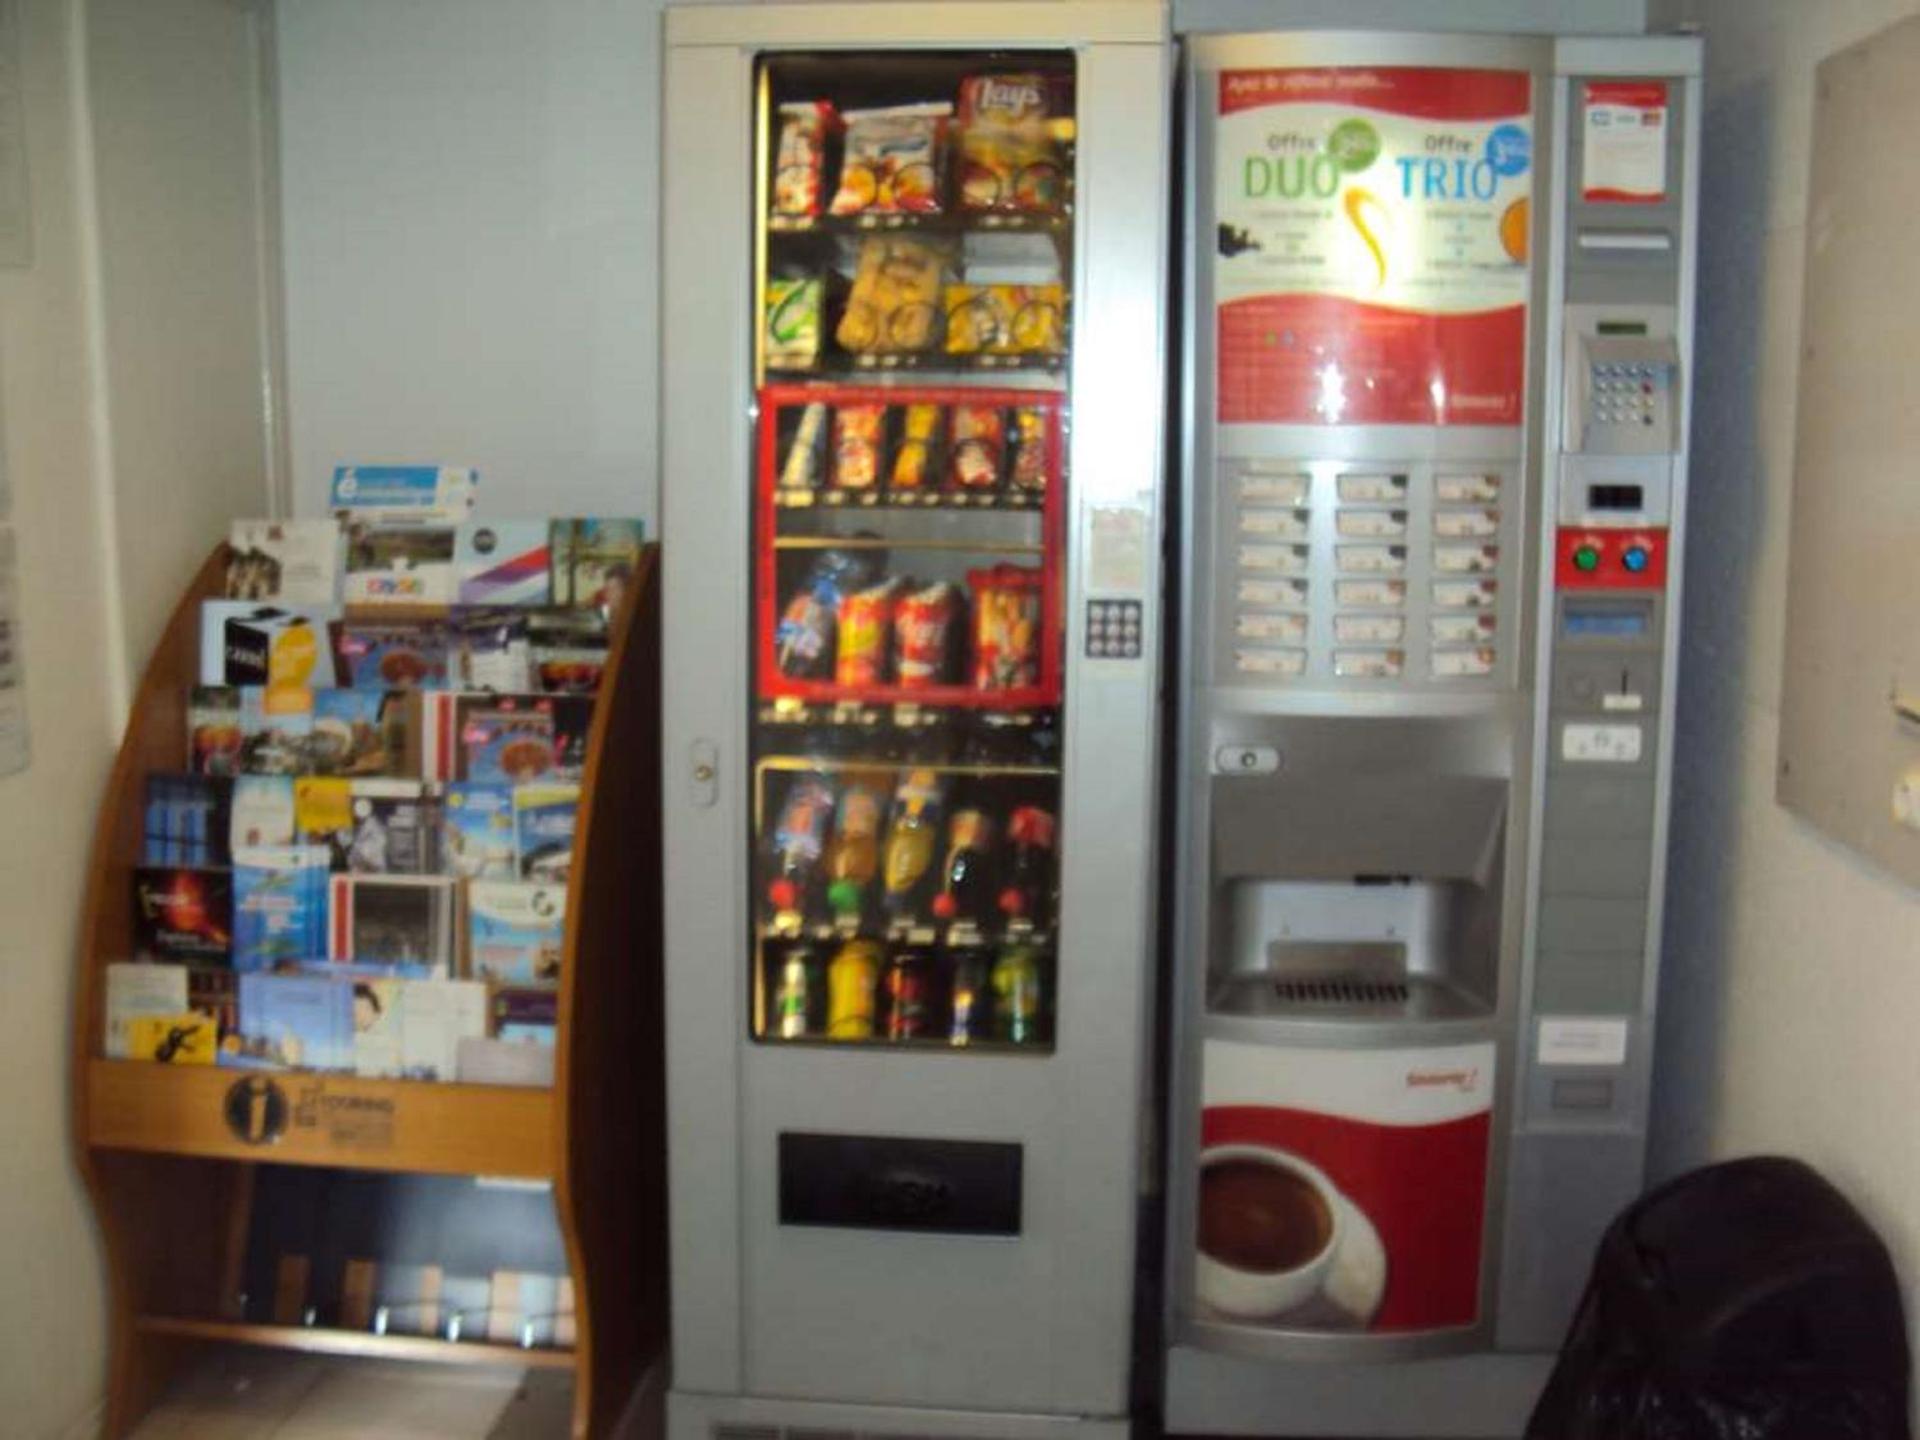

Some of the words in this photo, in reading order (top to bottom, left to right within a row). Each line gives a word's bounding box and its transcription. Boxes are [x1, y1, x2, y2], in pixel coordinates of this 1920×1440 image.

[1425, 134, 1472, 152] Offre
[1244, 155, 1339, 199] DUO
[1396, 156, 1498, 200] TRIO
